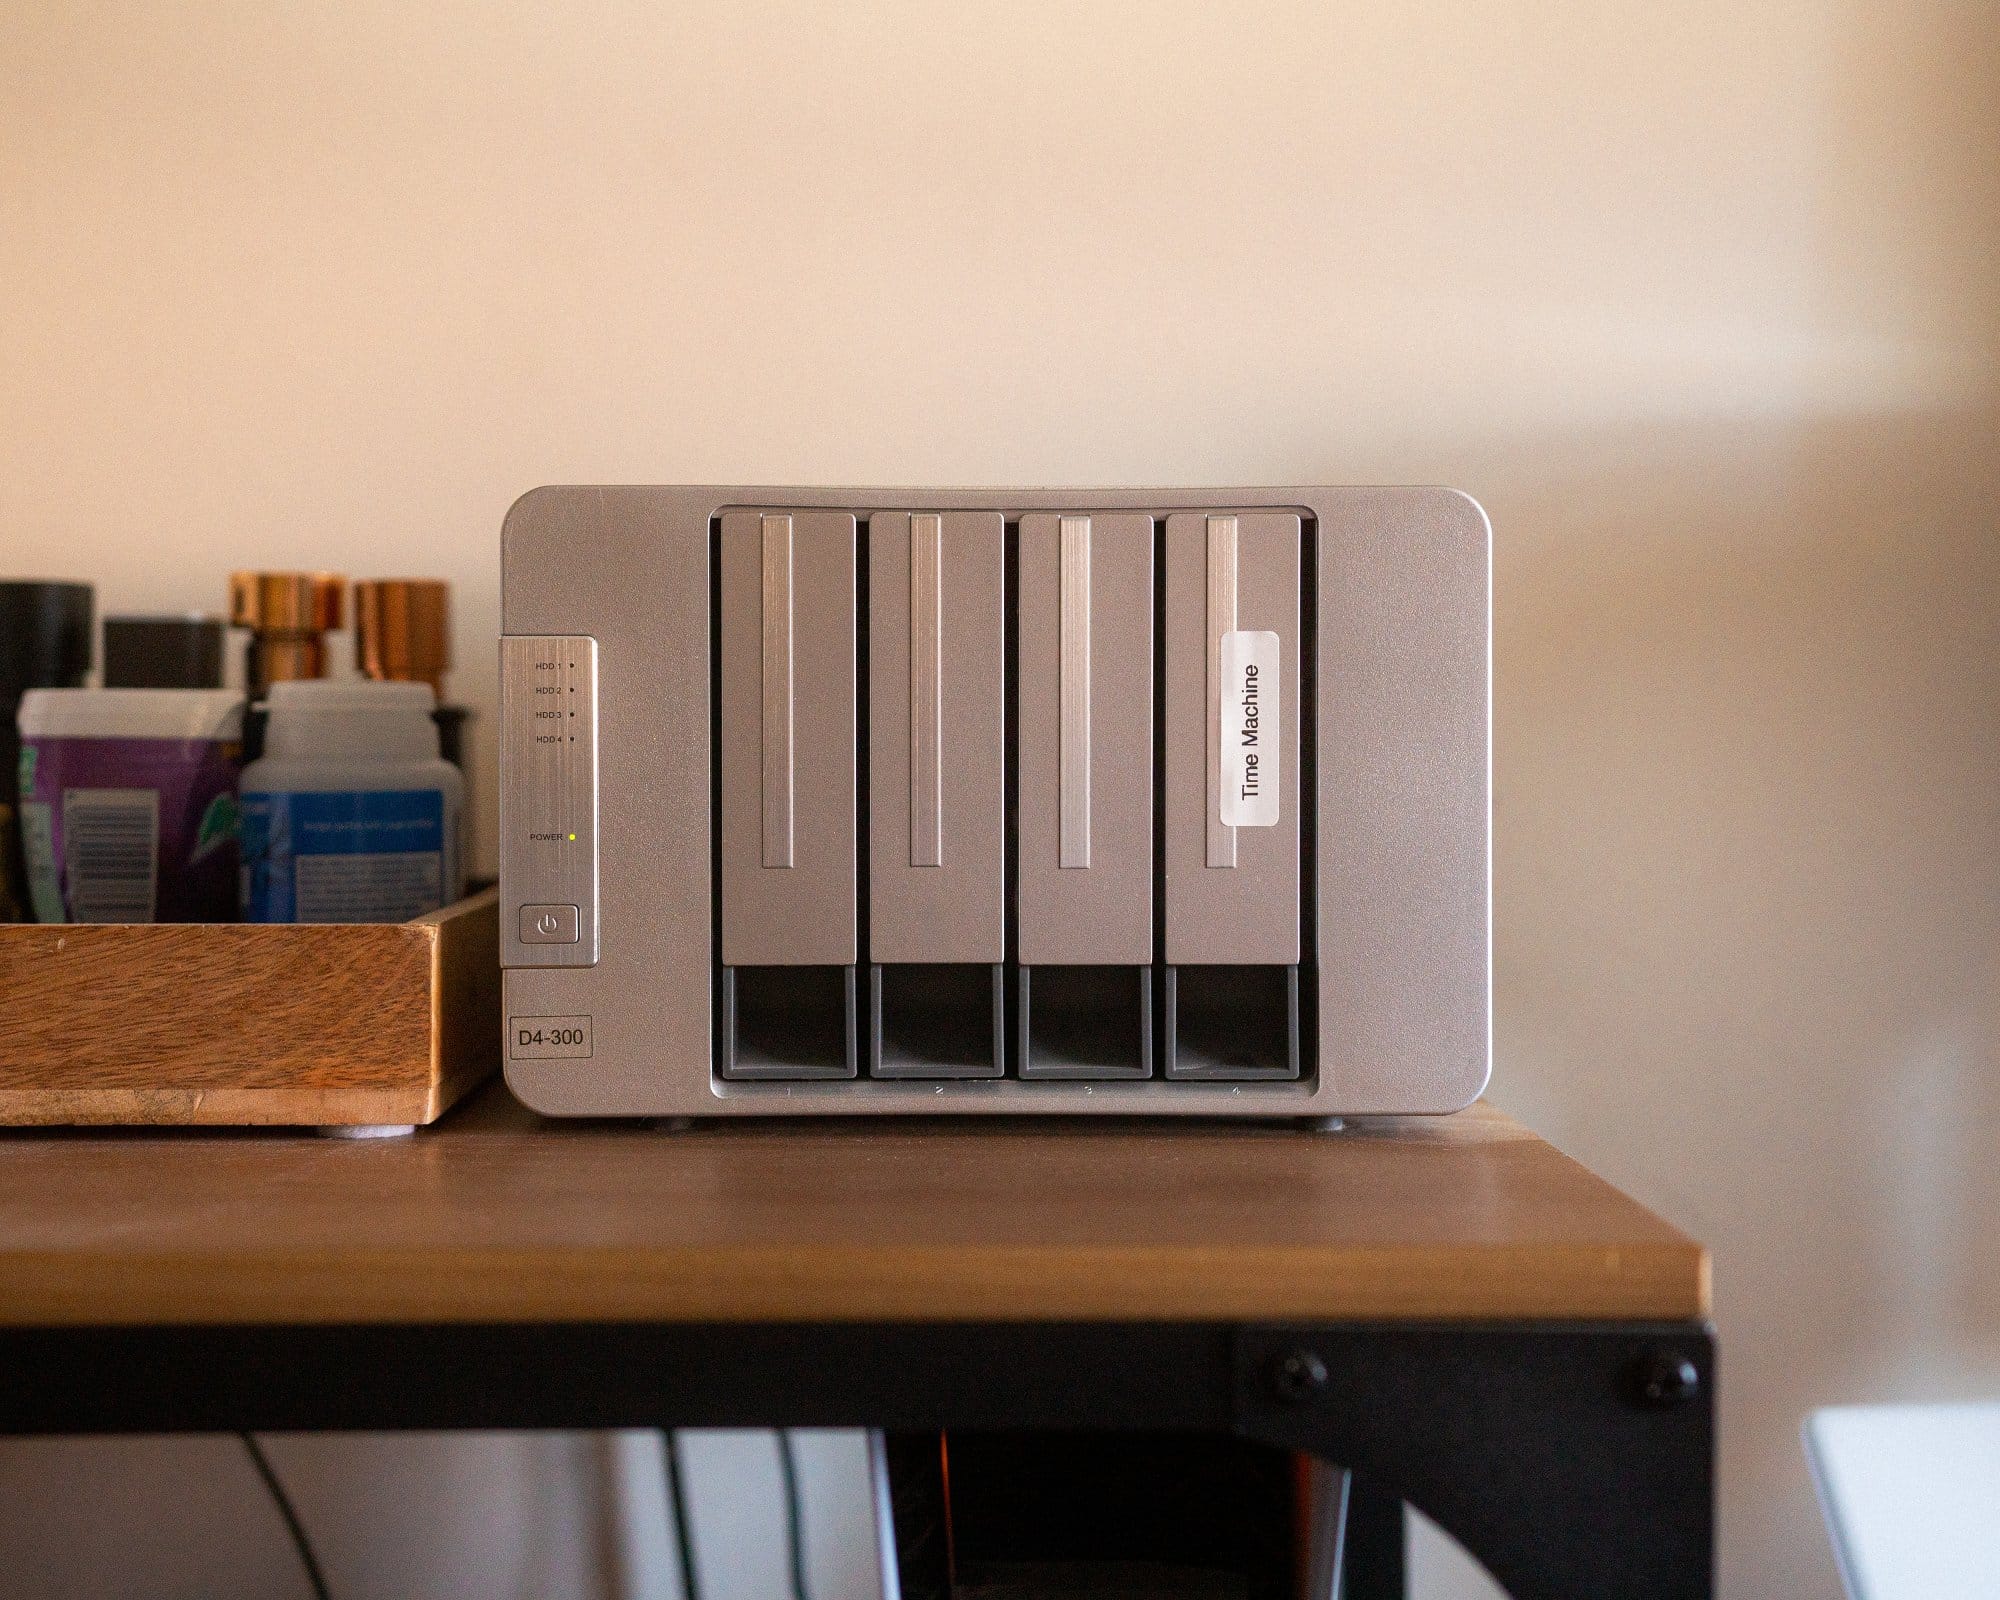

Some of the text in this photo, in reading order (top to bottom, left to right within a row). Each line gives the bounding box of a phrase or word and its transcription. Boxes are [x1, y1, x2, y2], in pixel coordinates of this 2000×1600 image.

[535, 662, 562, 670] HDD 1
[535, 711, 562, 719] HDD 3
[1241, 664, 1259, 801] Time Machine
[536, 735, 562, 743] HDD 4
[530, 833, 563, 841] POWER
[519, 1029, 583, 1046] D4-300
